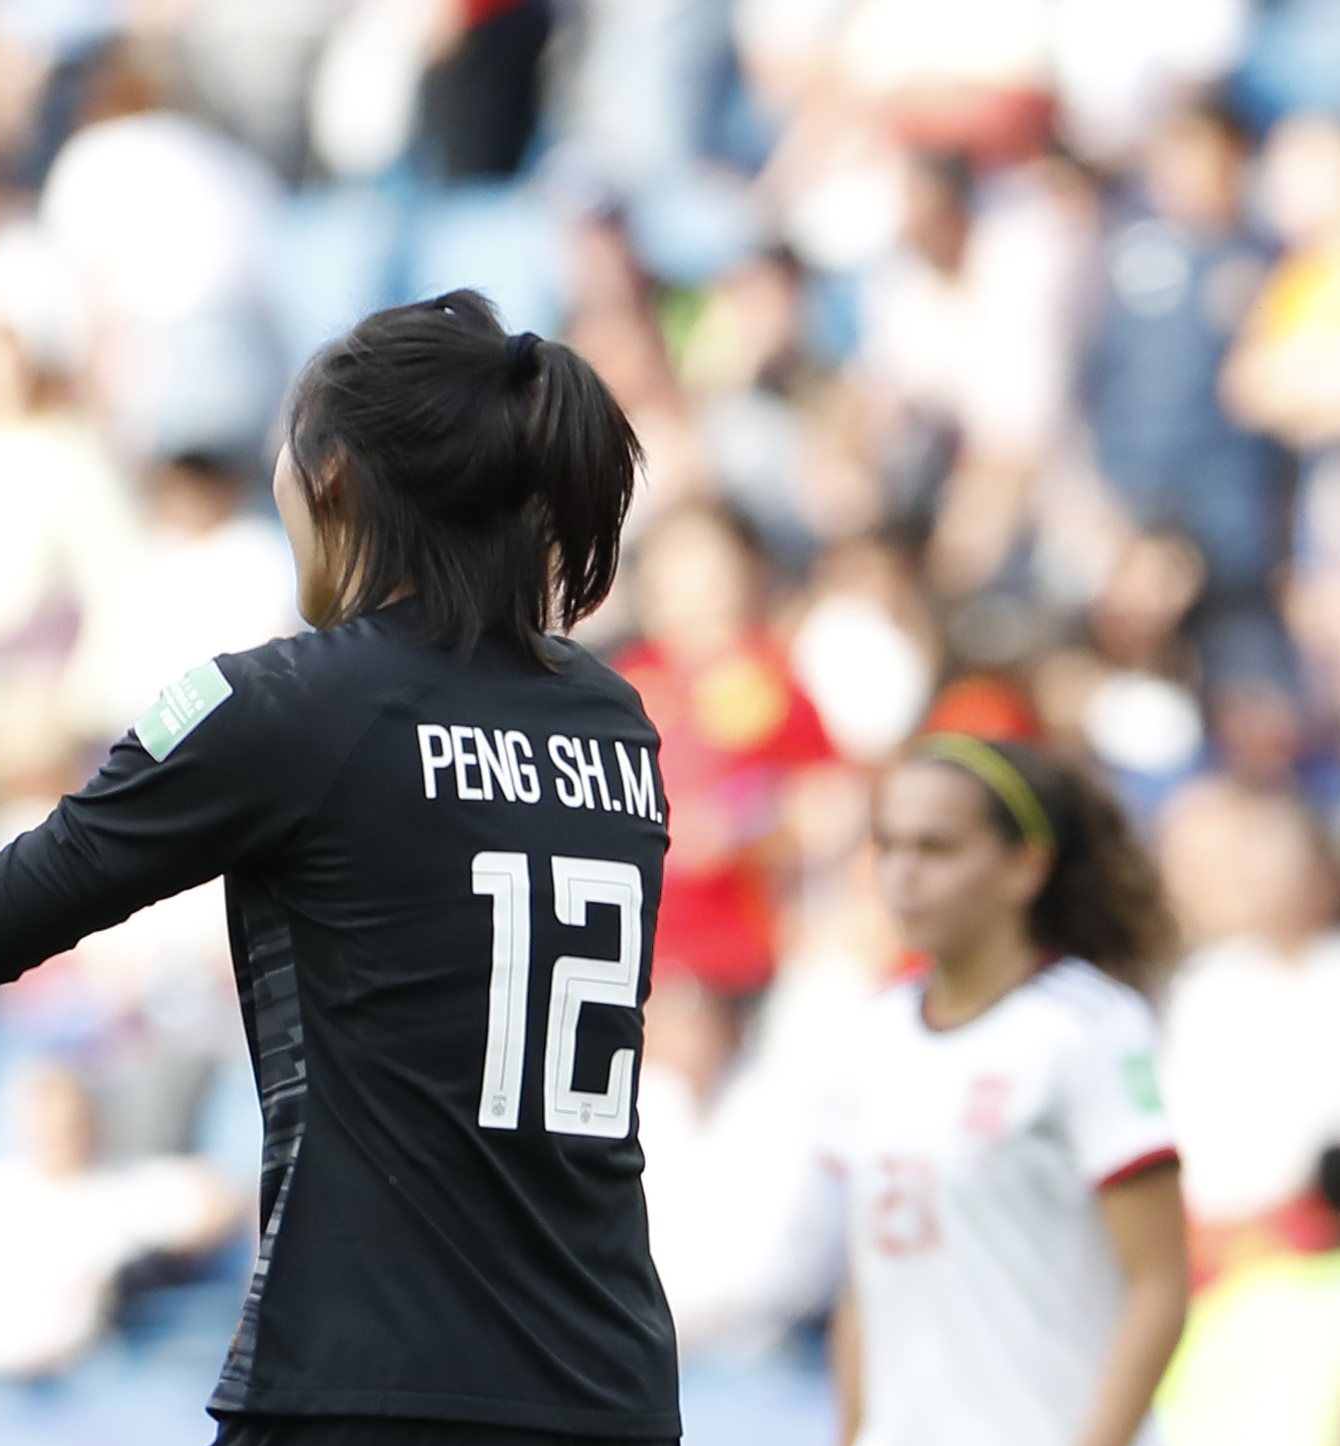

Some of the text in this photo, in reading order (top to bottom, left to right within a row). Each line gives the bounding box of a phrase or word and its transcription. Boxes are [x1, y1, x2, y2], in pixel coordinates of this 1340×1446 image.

[416, 723, 663, 824] PENG SH.M.
[471, 850, 644, 1139] 12
